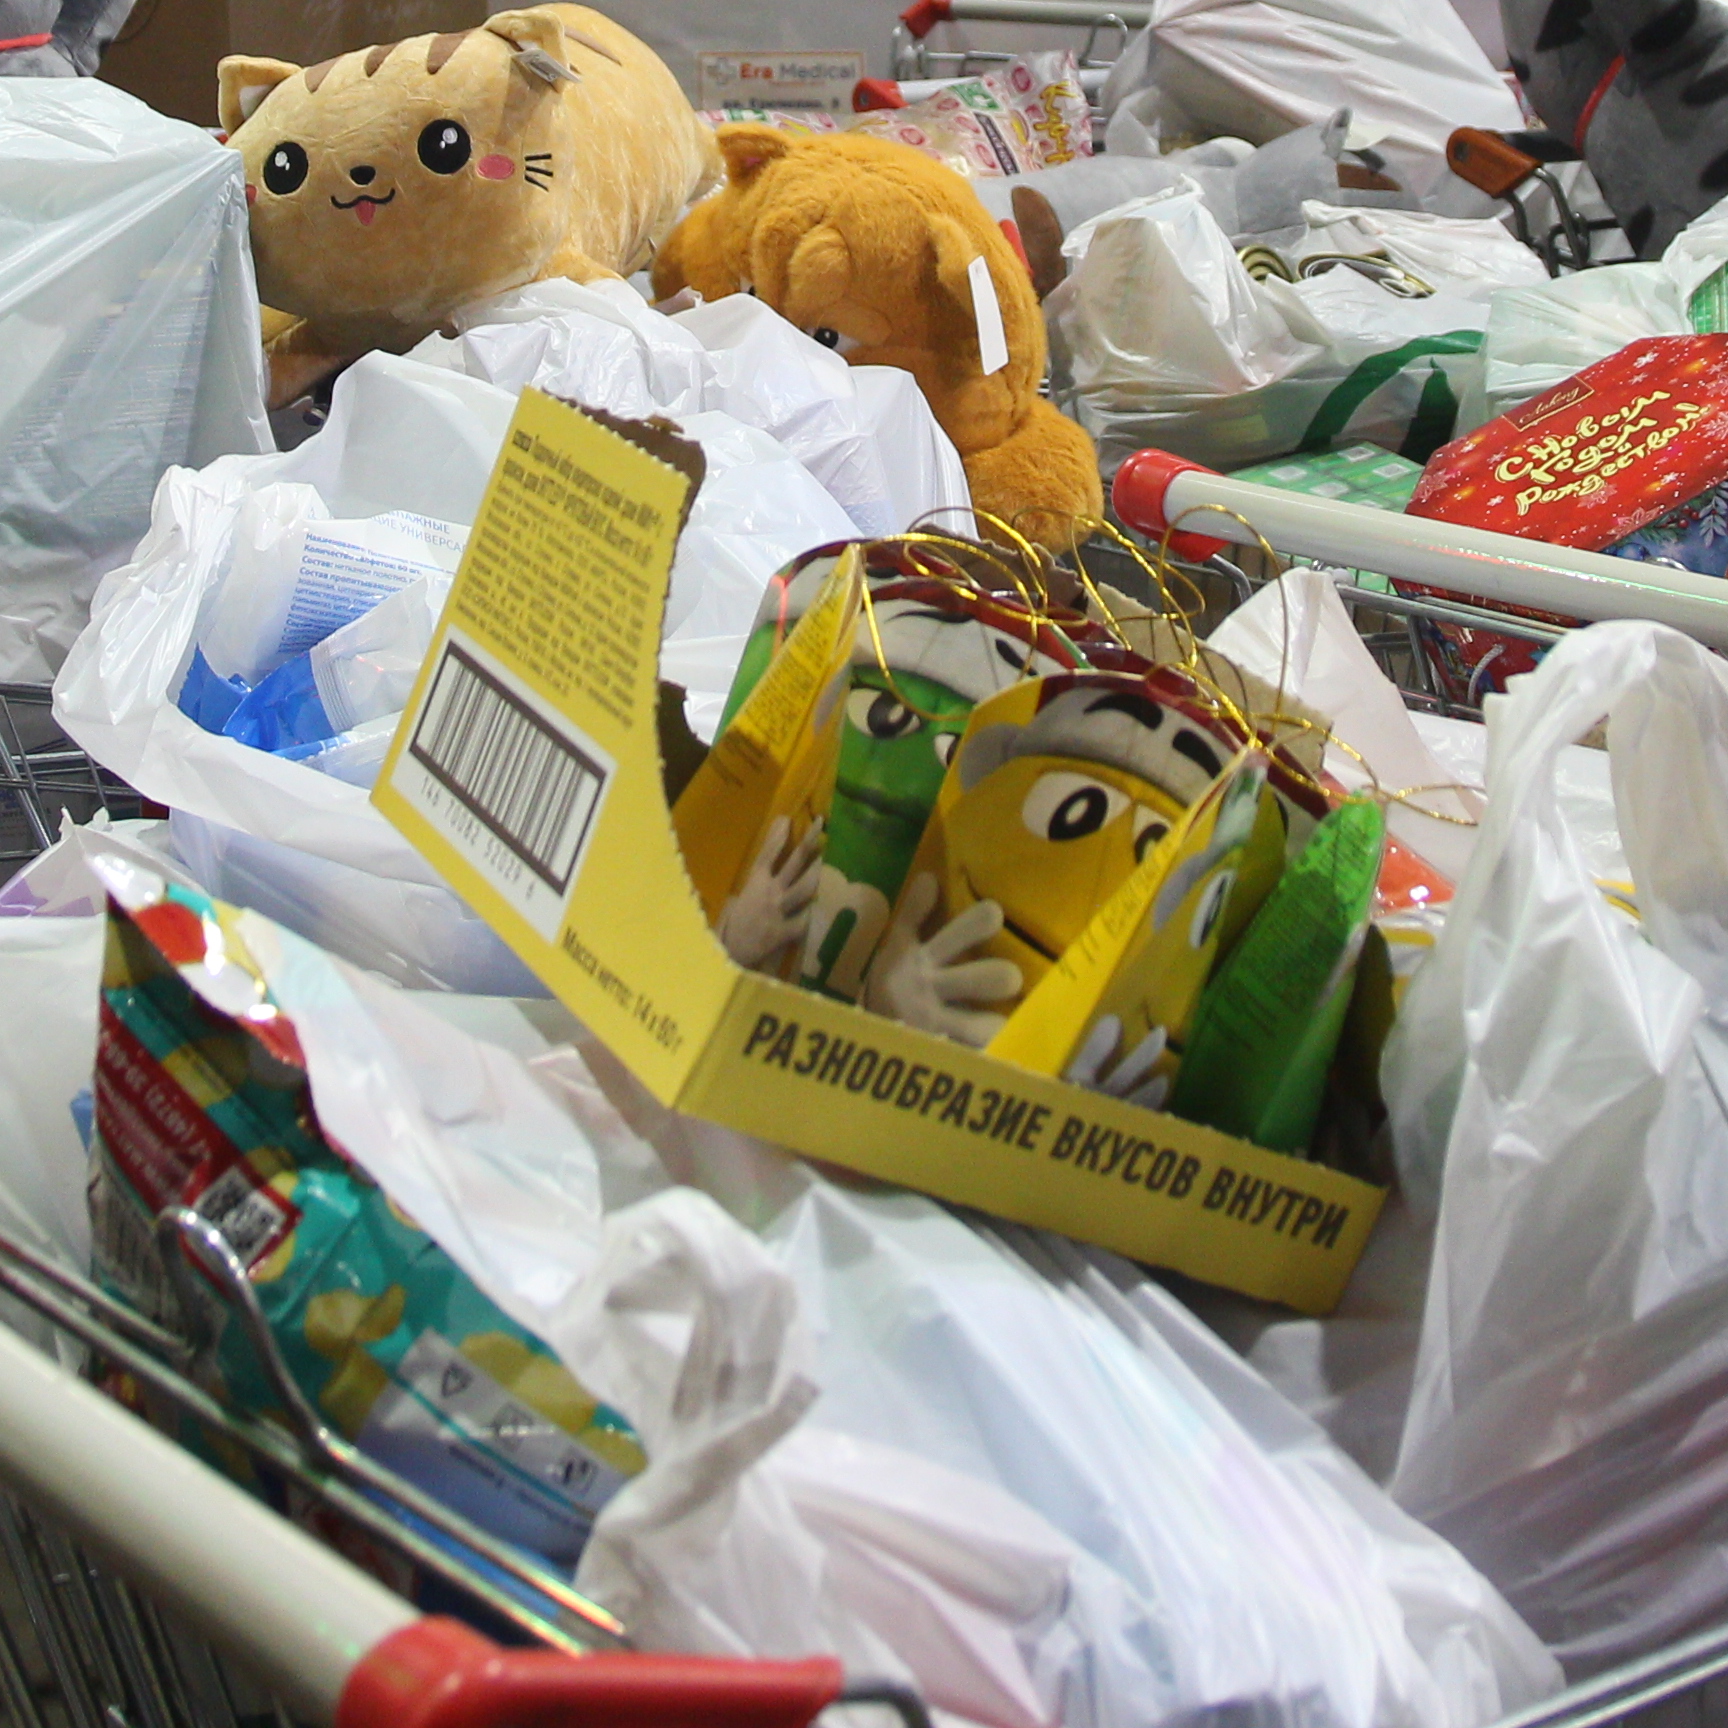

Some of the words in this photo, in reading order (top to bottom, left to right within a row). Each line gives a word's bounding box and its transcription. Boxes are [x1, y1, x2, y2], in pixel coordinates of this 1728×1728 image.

[1495, 456, 1534, 483] С
[742, 1012, 1053, 1151] РАЗНООБРАЗИЕ
[1050, 1113, 1203, 1201] ВКУСОВ
[1202, 1165, 1351, 1251] ВНУТРИ
